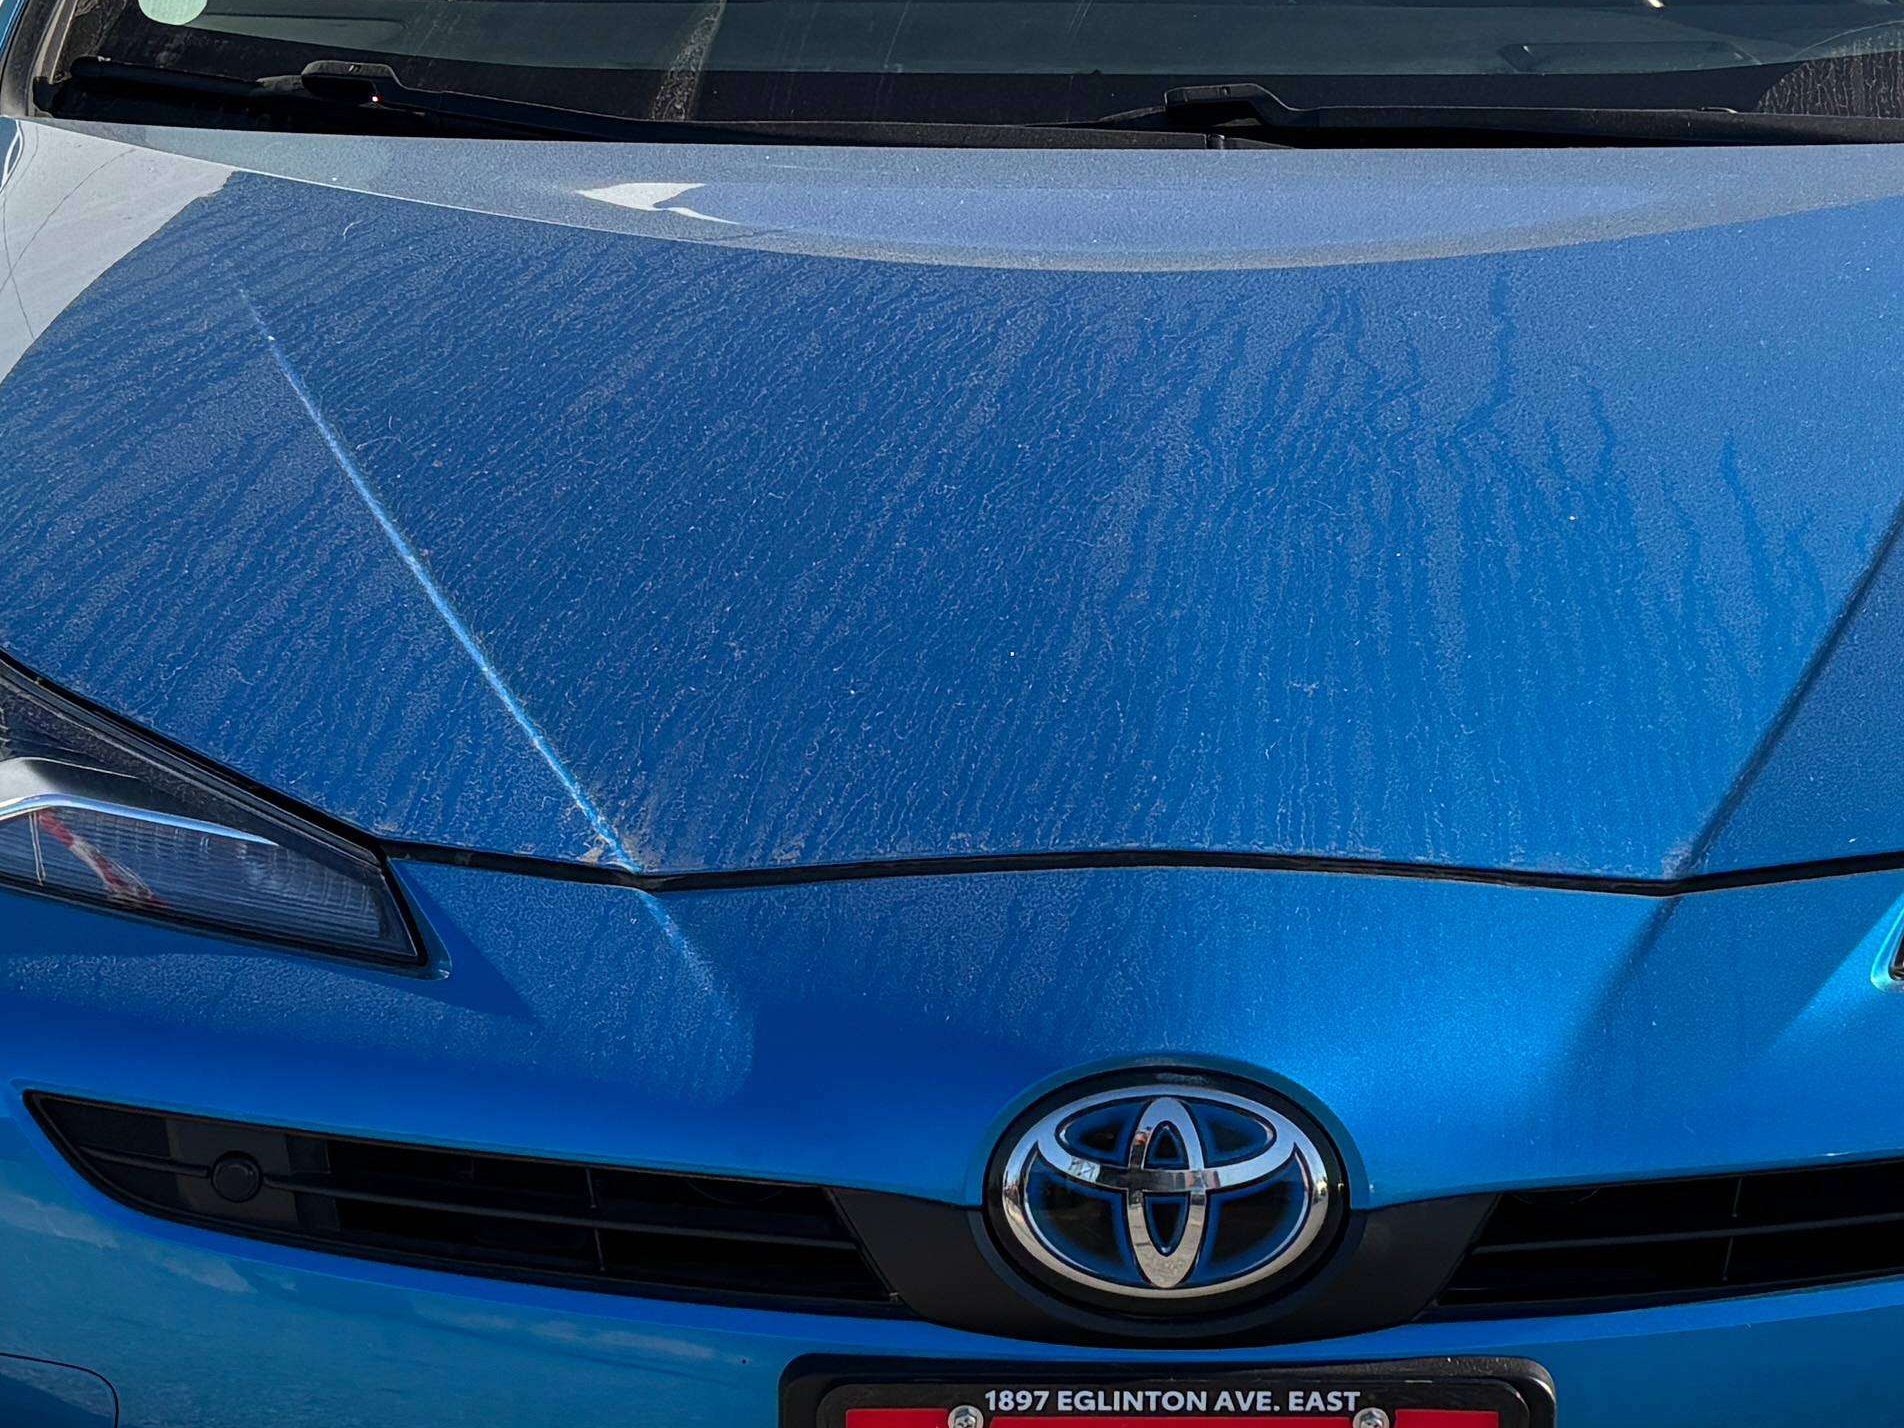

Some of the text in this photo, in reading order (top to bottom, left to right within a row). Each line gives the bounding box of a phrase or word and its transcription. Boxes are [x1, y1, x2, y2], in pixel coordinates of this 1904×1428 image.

[985, 1390, 1361, 1413] 1897 EGLINTON AVE. EAST
